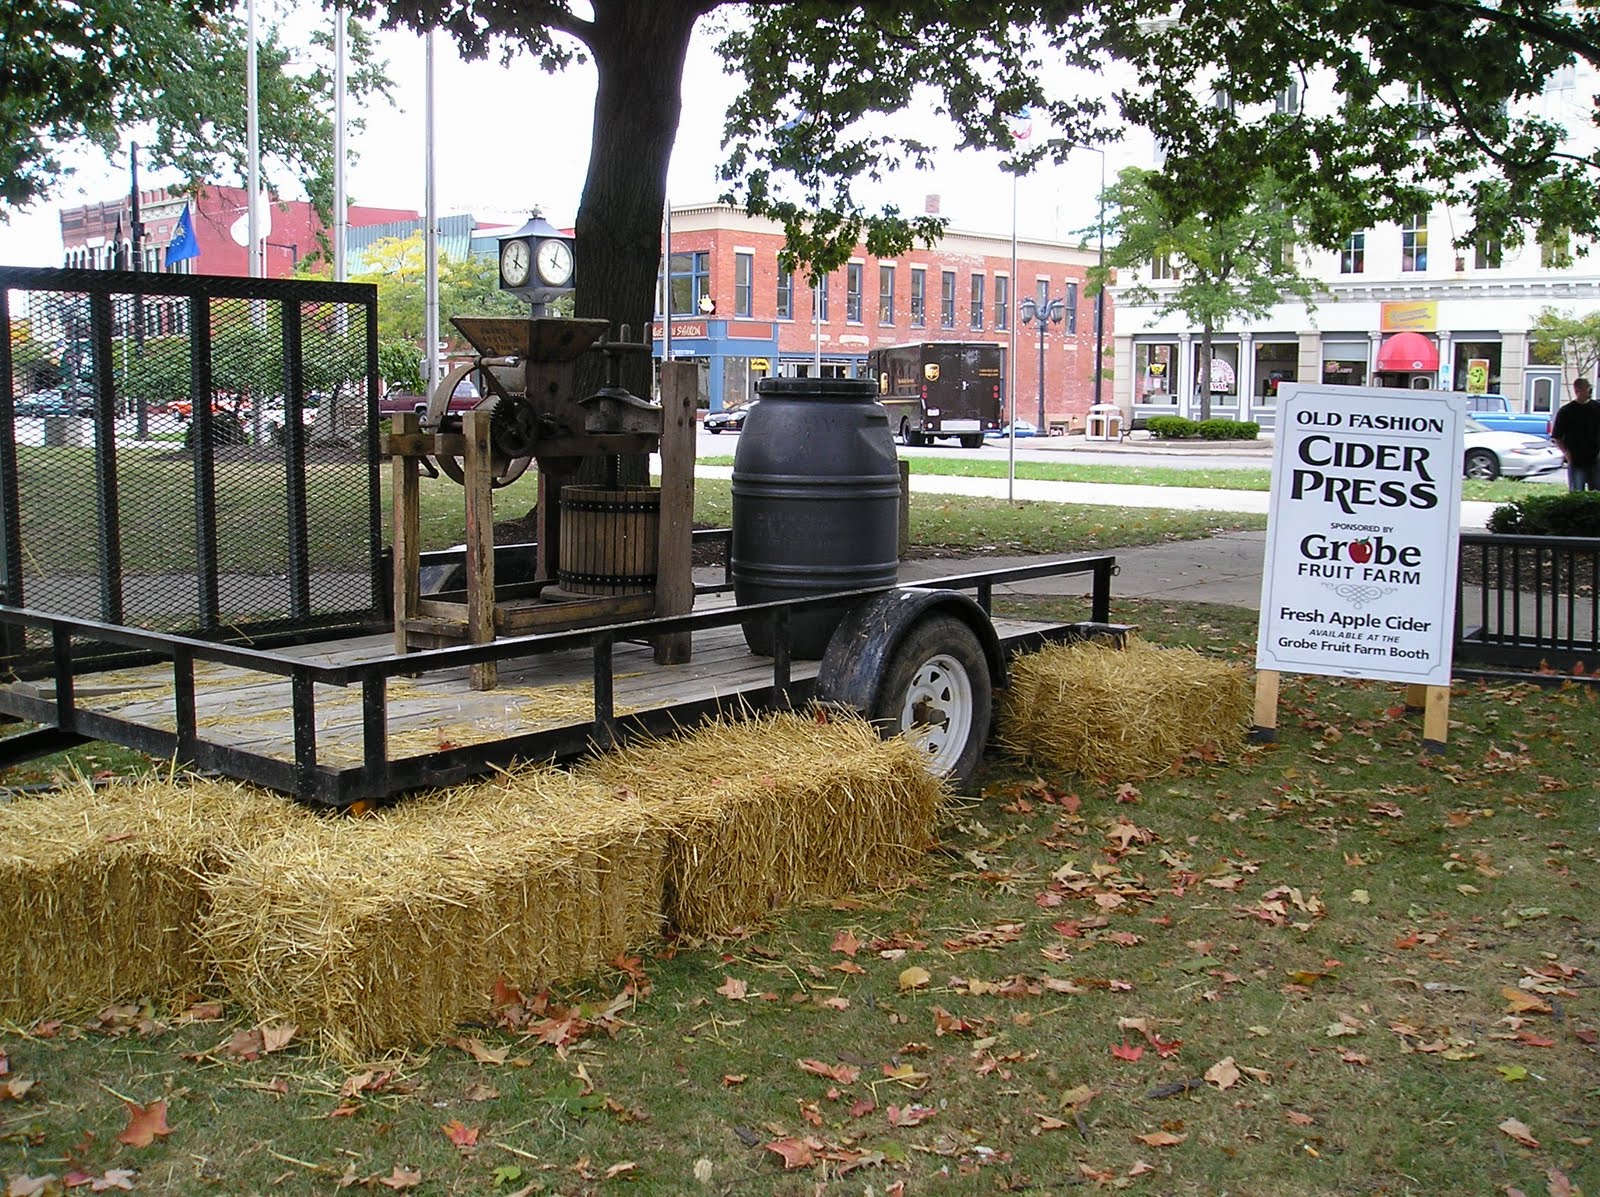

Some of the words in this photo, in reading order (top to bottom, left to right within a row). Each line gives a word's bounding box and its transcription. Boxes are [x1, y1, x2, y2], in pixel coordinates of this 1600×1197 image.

[1297, 411, 1342, 426] OLD
[1349, 414, 1443, 433] FASHION
[1298, 435, 1435, 481] CIDER
[1291, 468, 1438, 514] PRESS
[1331, 523, 1380, 532] SPONSORED
[1299, 563, 1354, 579] FRUIT
[1364, 568, 1420, 584] FARM
[1281, 608, 1324, 623] Fresh
[1329, 612, 1381, 629] Apple
[1386, 616, 1431, 632] Cider
[1310, 630, 1362, 639] AVAILABLE
[1383, 635, 1400, 643] THE
[1279, 637, 1317, 649] Grobe
[1321, 641, 1350, 652] Fruit
[1355, 644, 1385, 655] Farm
[1390, 647, 1429, 659] Booth
